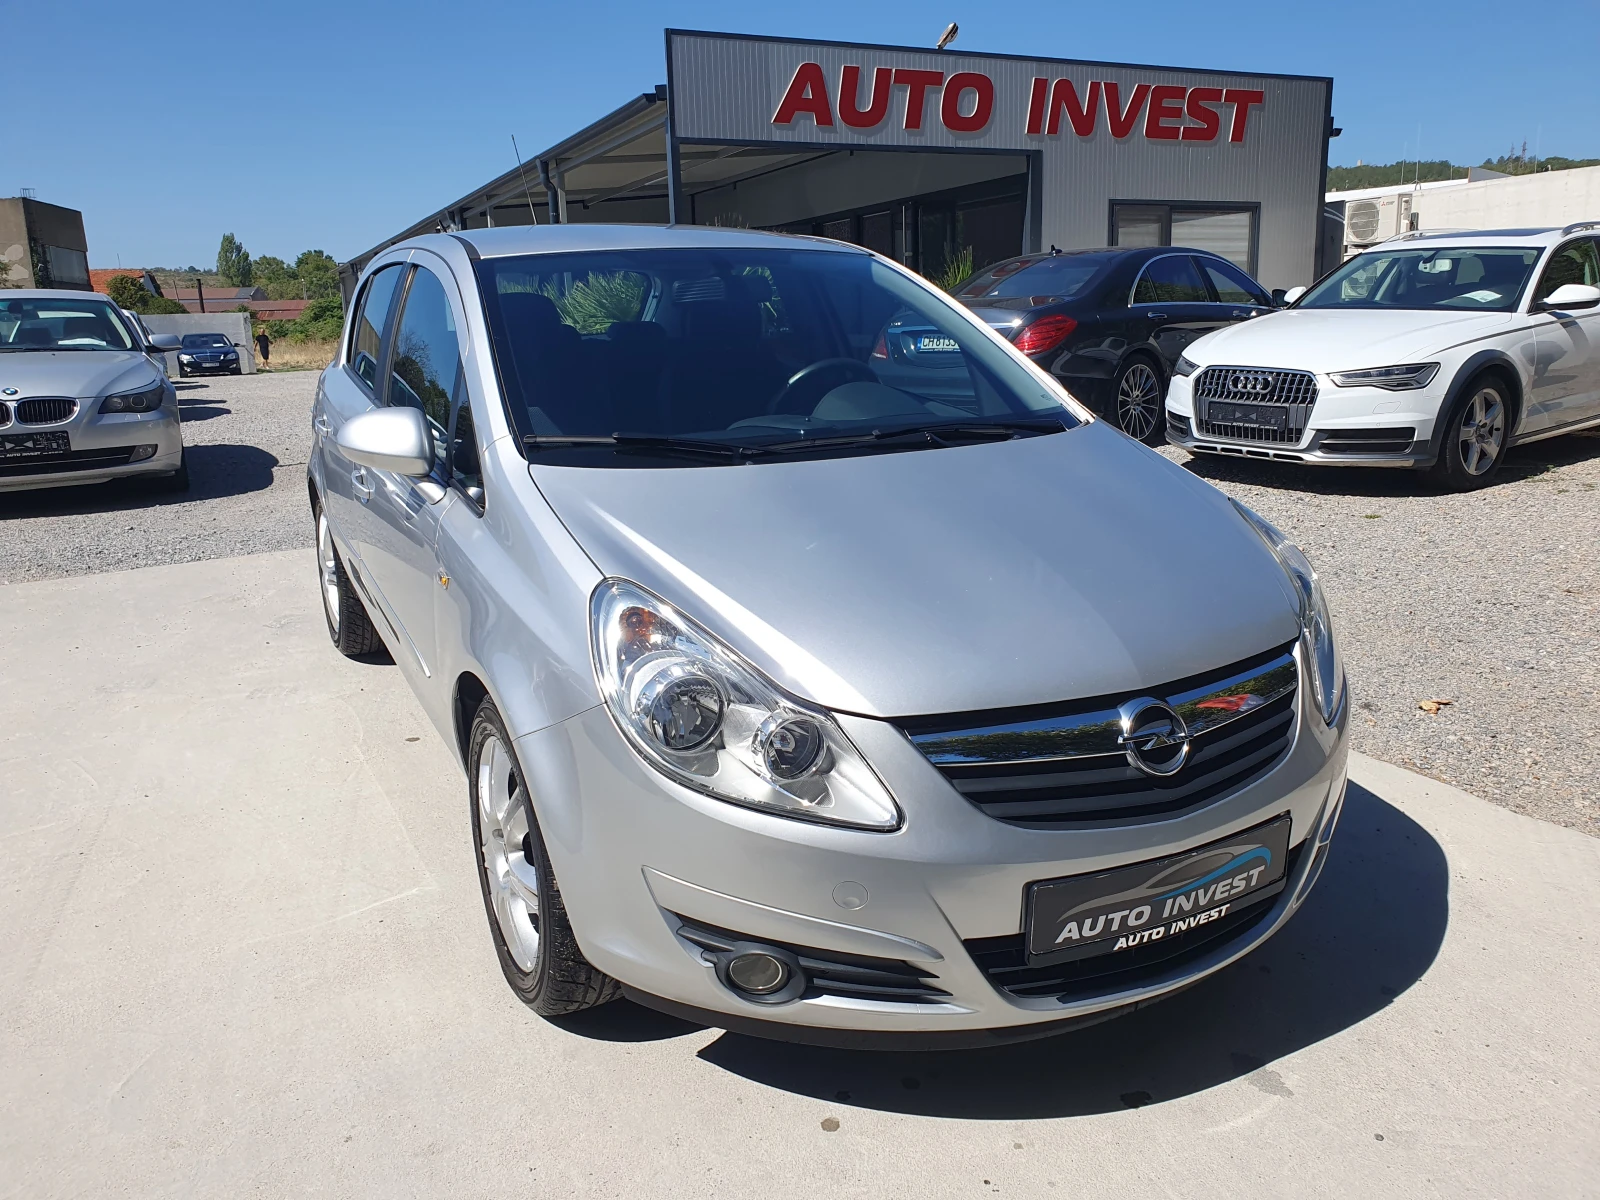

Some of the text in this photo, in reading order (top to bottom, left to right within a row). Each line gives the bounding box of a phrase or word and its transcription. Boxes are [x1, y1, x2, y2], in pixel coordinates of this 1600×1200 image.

[771, 62, 1265, 143] AUTO INVEST
[1054, 865, 1265, 944] AUTO INVEST
[1113, 904, 1231, 951] AUTO INVEST
